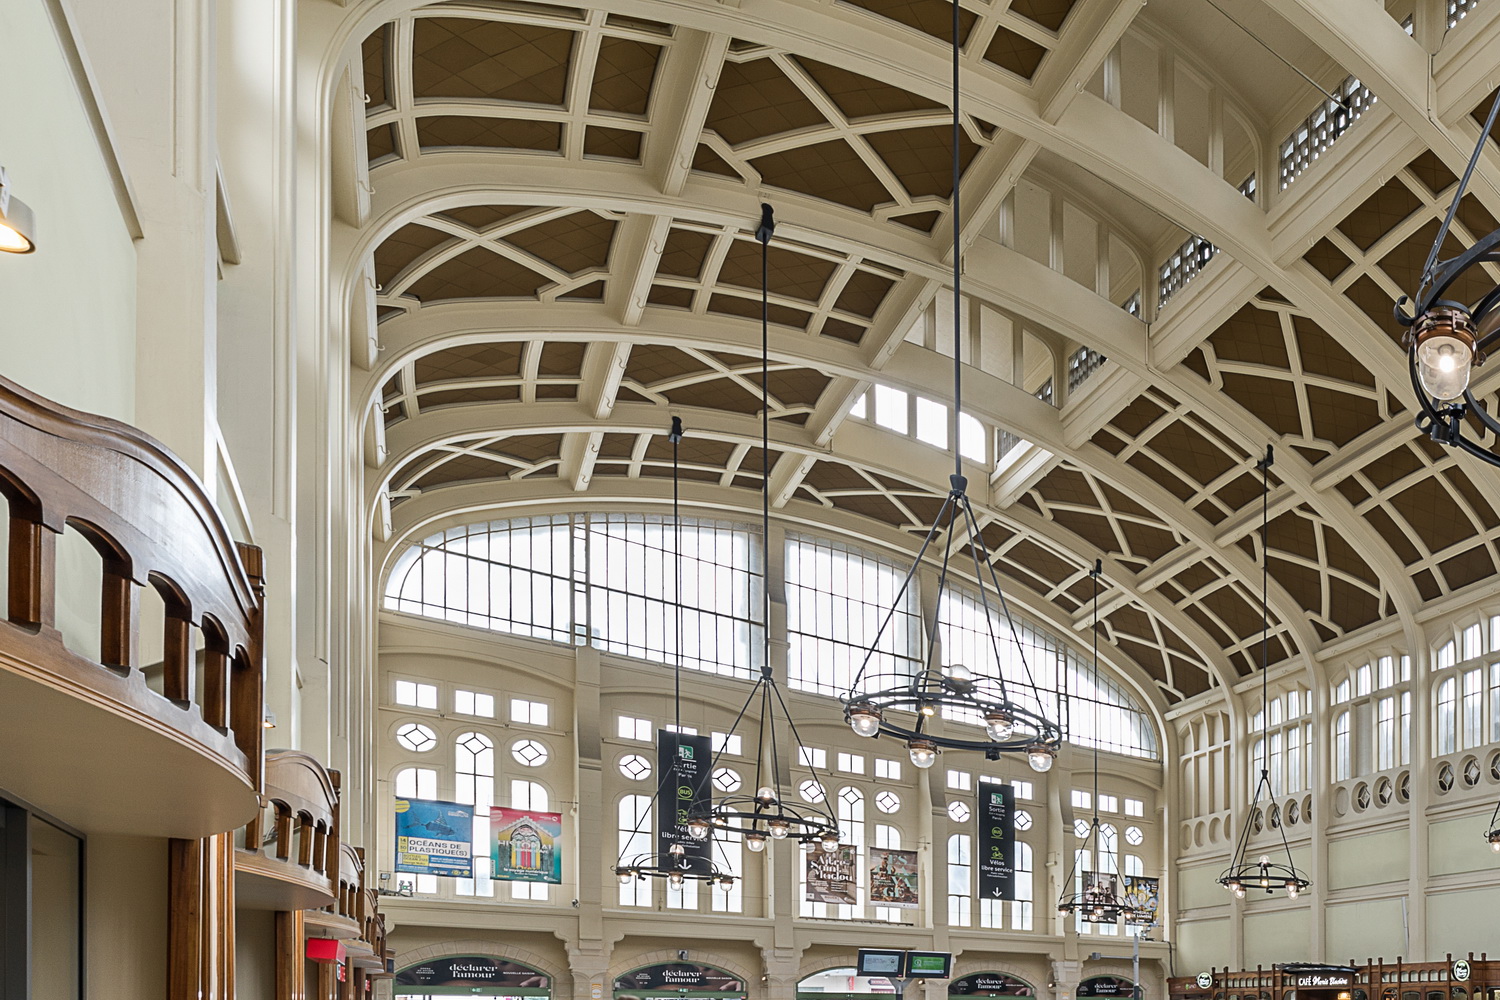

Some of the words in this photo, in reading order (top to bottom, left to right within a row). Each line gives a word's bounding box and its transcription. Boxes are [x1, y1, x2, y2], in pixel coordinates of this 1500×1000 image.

[988, 806, 1005, 814] Sortie
[409, 845, 468, 857] PLASTIQUE(S)
[994, 866, 1013, 874] service
[449, 963, 498, 972] déclarer
[662, 969, 702, 977] déclarer
[1298, 975, 1312, 986] CAFÉ
